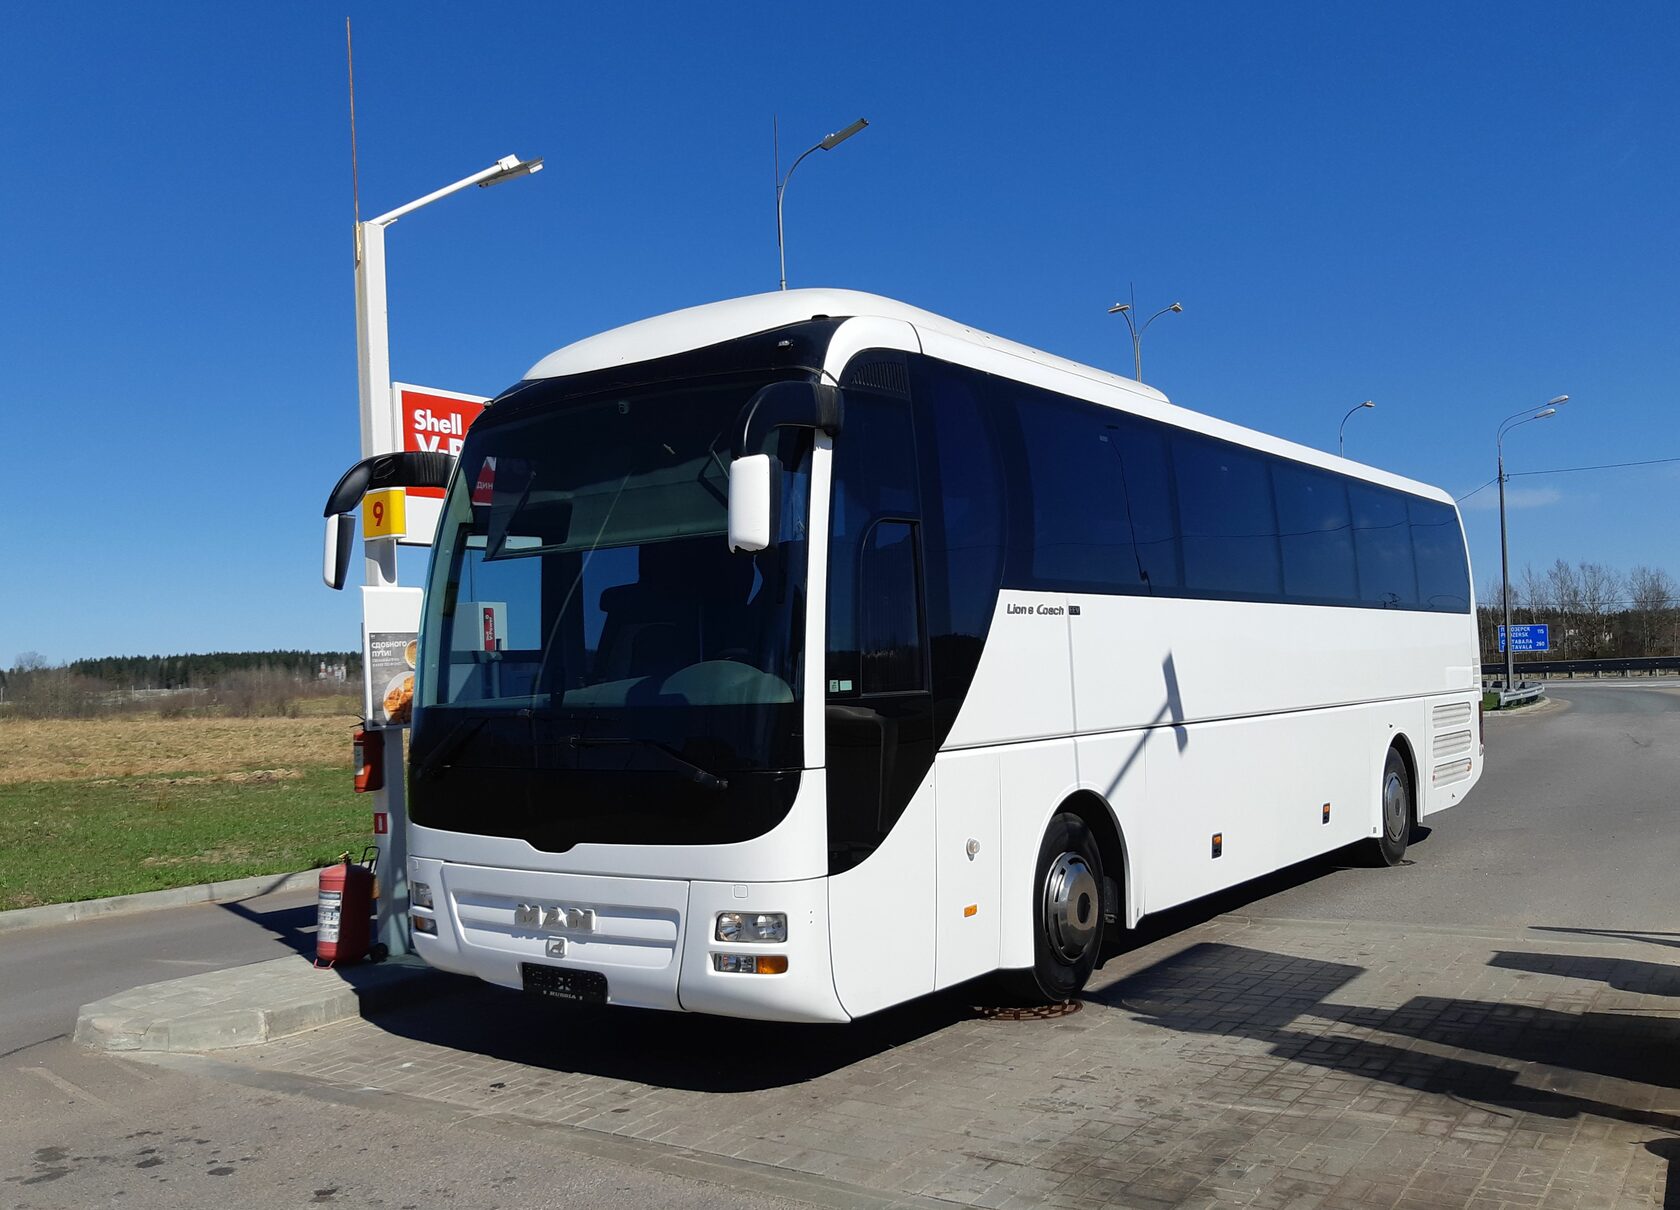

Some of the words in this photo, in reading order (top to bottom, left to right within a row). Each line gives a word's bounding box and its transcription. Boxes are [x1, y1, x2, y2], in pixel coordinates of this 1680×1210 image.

[414, 409, 463, 436] Shell
[372, 501, 385, 527] 9
[1036, 603, 1065, 615] Coach
[515, 903, 596, 931] MAN
